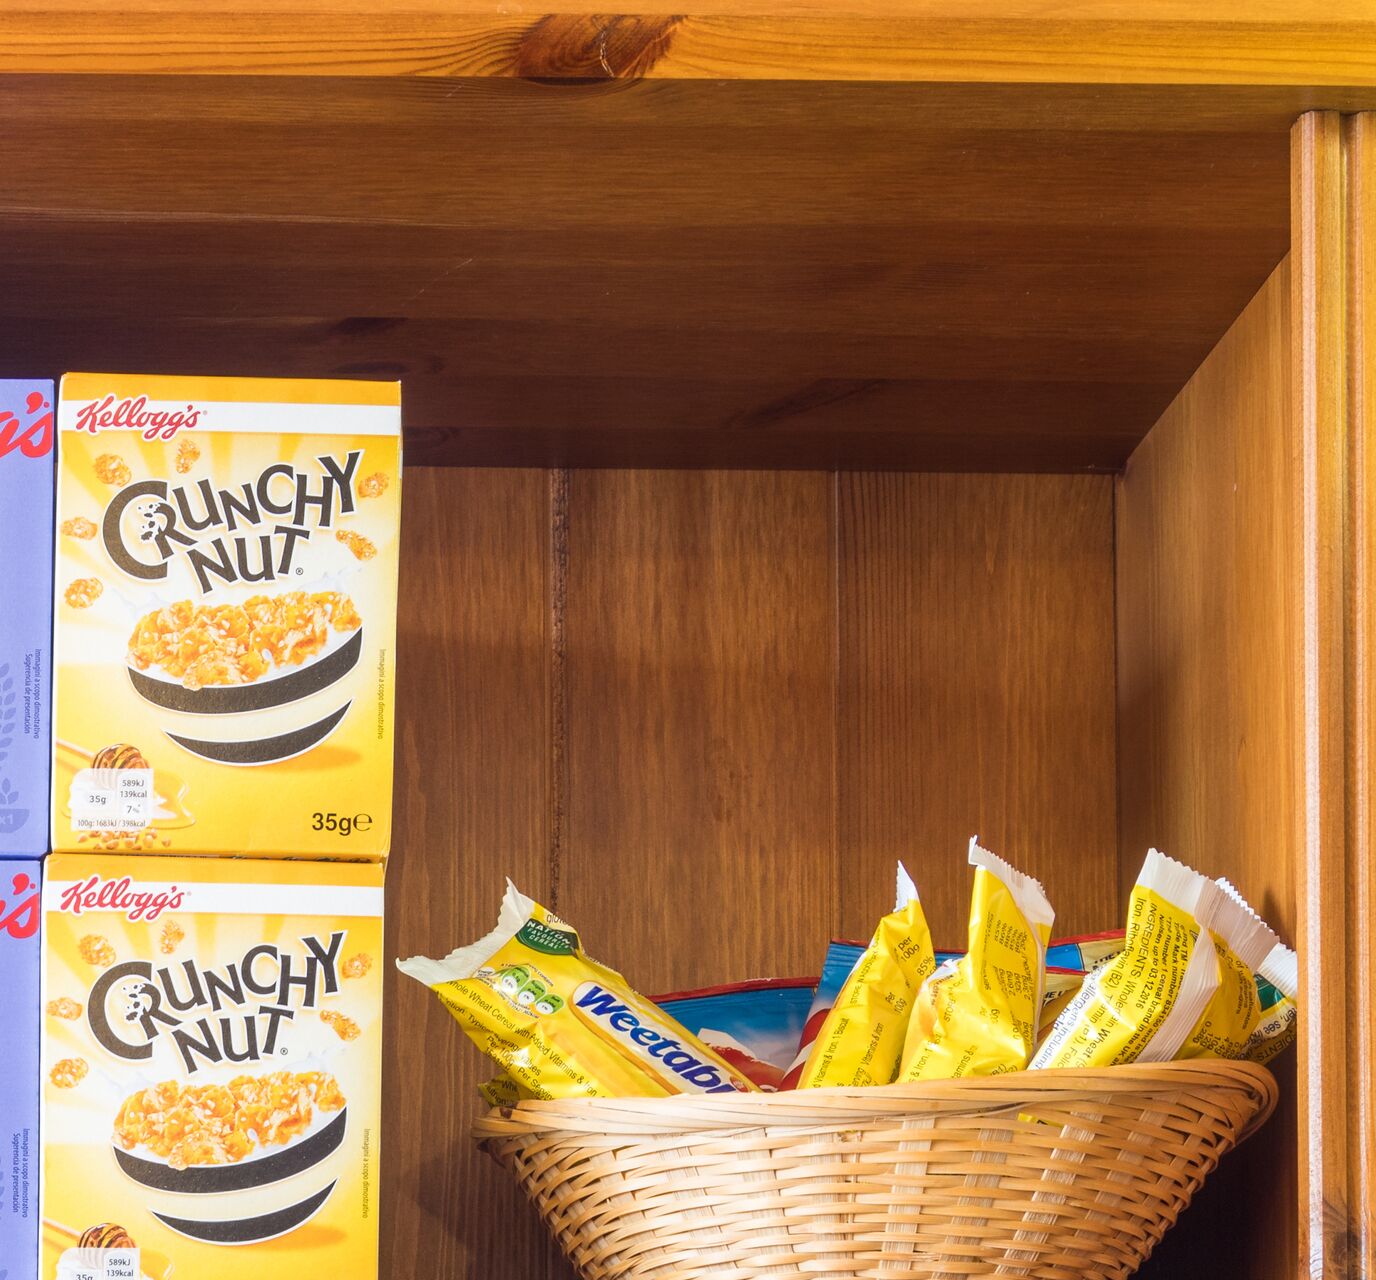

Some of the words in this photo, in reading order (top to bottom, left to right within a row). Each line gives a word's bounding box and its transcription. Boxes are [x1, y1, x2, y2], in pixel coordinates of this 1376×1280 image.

[76, 396, 198, 438] Kellogg's
[102, 449, 363, 580] CRUNCHY
[186, 526, 310, 594] NUT
[89, 795, 107, 805] 35g
[120, 790, 148, 798] 139kcal
[122, 779, 144, 787] 589kJ
[61, 878, 184, 919] Kellogg's
[897, 936, 913, 952] per
[900, 944, 921, 963] 100g
[1116, 922, 1141, 970] Riboflavin
[87, 932, 344, 1060] CRUNCHY
[171, 1006, 295, 1074] NUT
[469, 991, 493, 1011] Wheat
[491, 1009, 515, 1030] Cereal
[548, 1050, 581, 1080] Vitamins
[1086, 1027, 1111, 1058] Wheat
[106, 1269, 134, 1277] 139kcal
[108, 1258, 131, 1266] 589kJ
